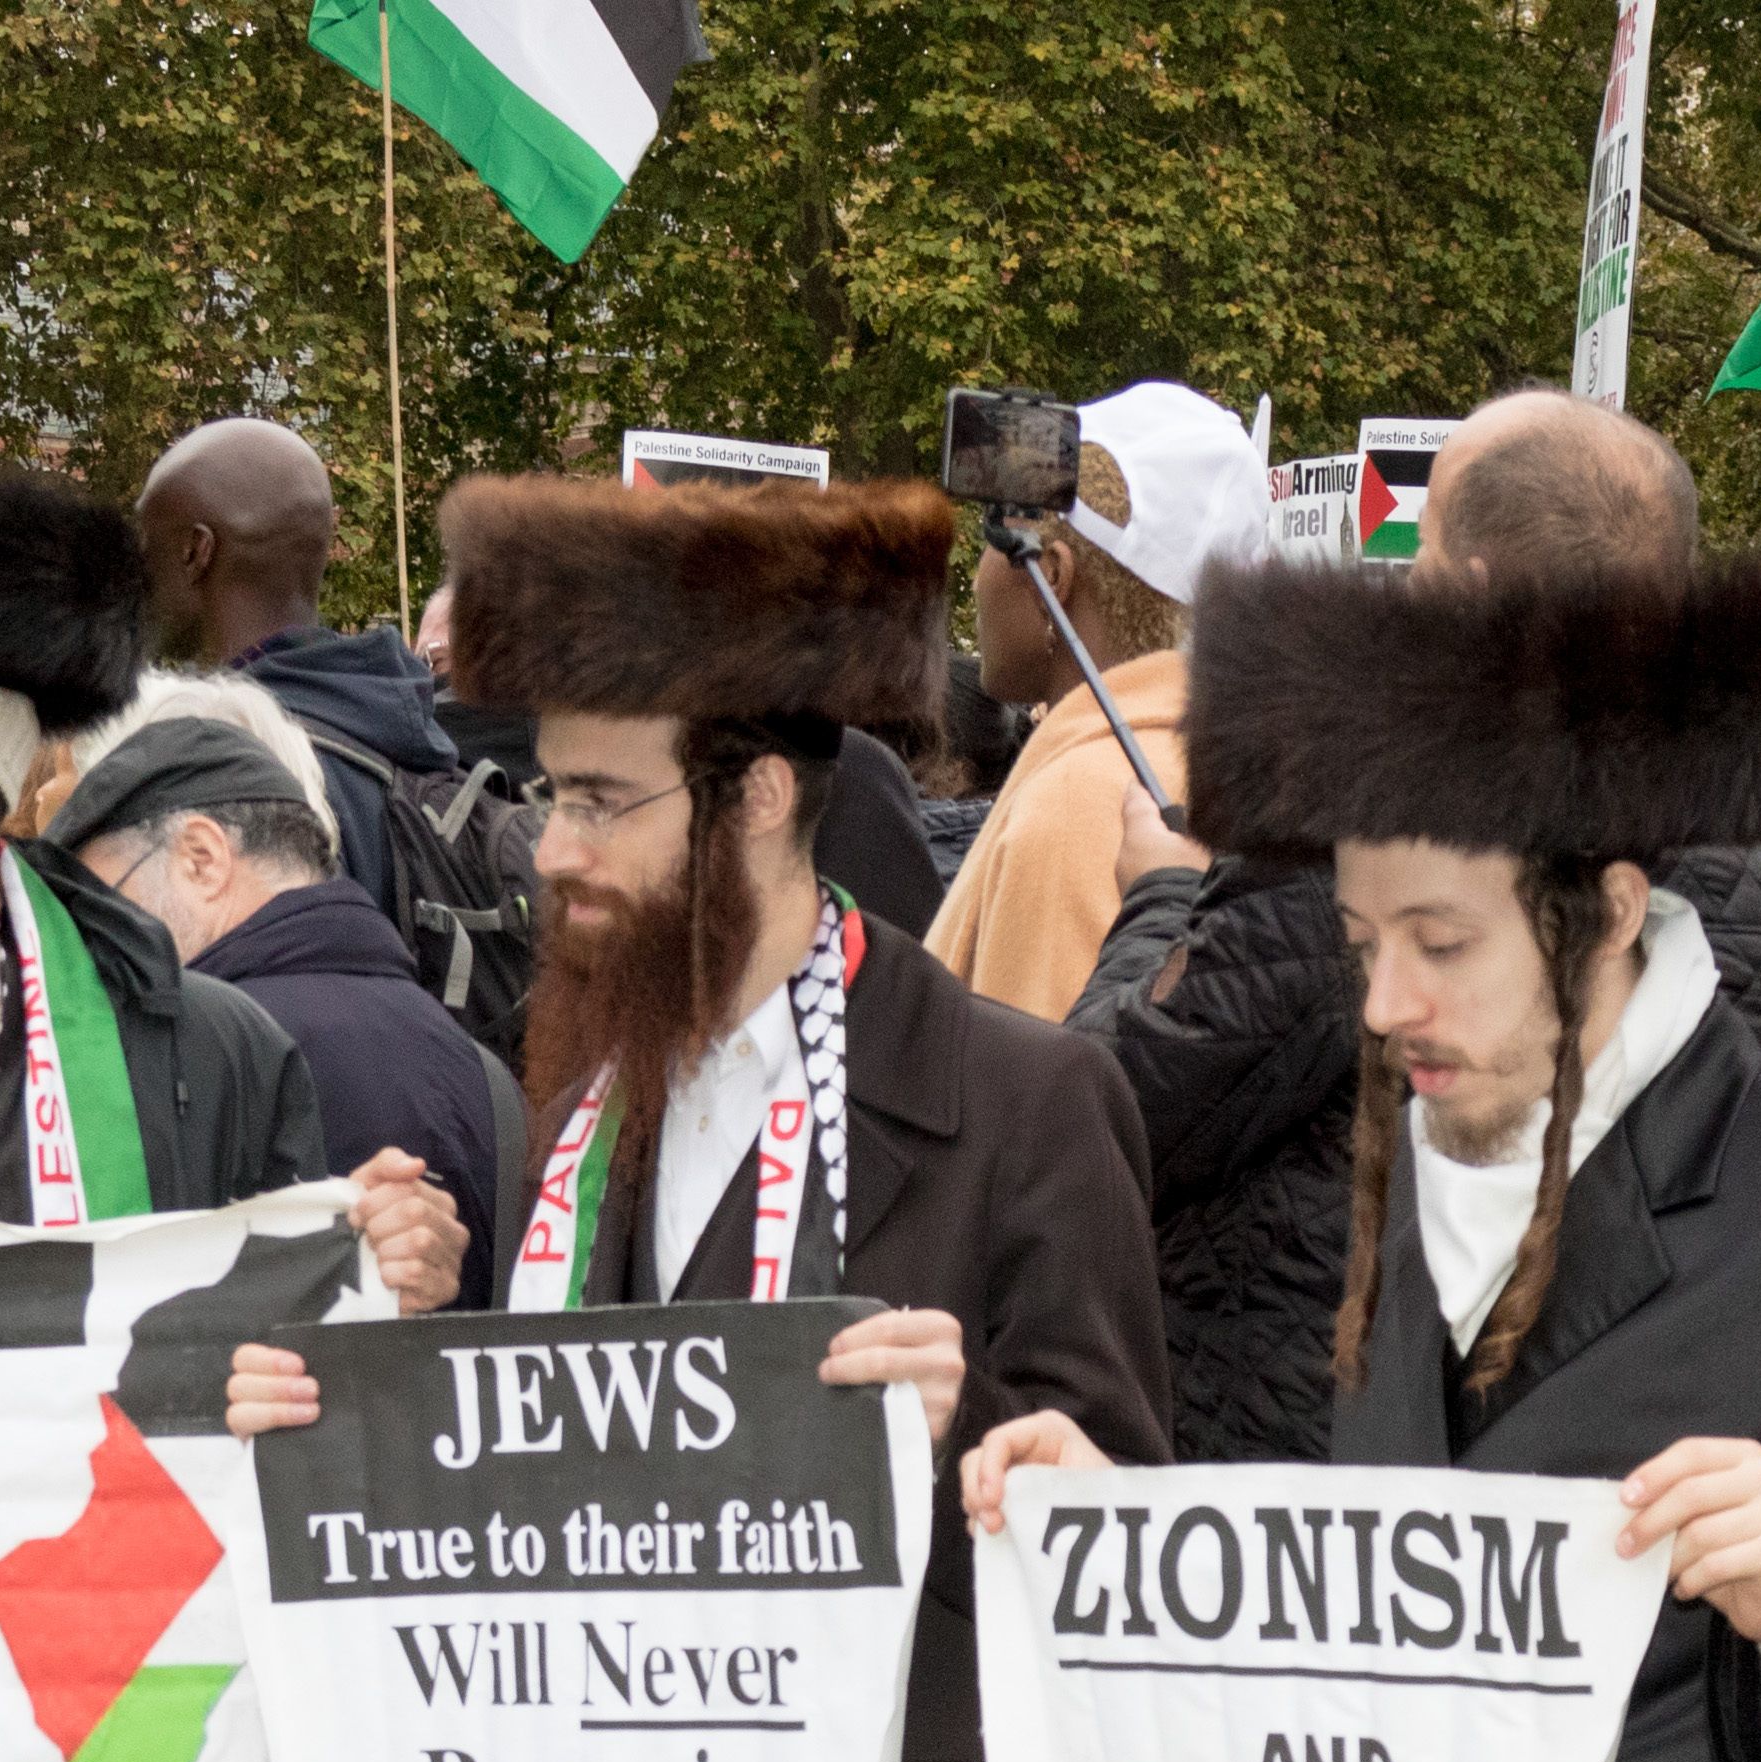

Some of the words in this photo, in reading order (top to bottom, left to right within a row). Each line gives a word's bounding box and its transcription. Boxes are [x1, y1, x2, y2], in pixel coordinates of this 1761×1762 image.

[635, 440, 691, 457] Palestine
[696, 446, 754, 466] Solidarity
[757, 453, 821, 474] Campaign
[1367, 431, 1416, 445] Palestine
[1282, 502, 1327, 541] Irael
[433, 1336, 736, 1469] JEWS
[308, 1512, 476, 1585] True
[487, 1509, 546, 1578] to
[563, 1503, 705, 1577] their
[716, 1500, 862, 1574] faith
[1041, 1505, 1582, 1659] ZIONISM
[394, 1621, 554, 1707] Will
[580, 1620, 799, 1707] Never
